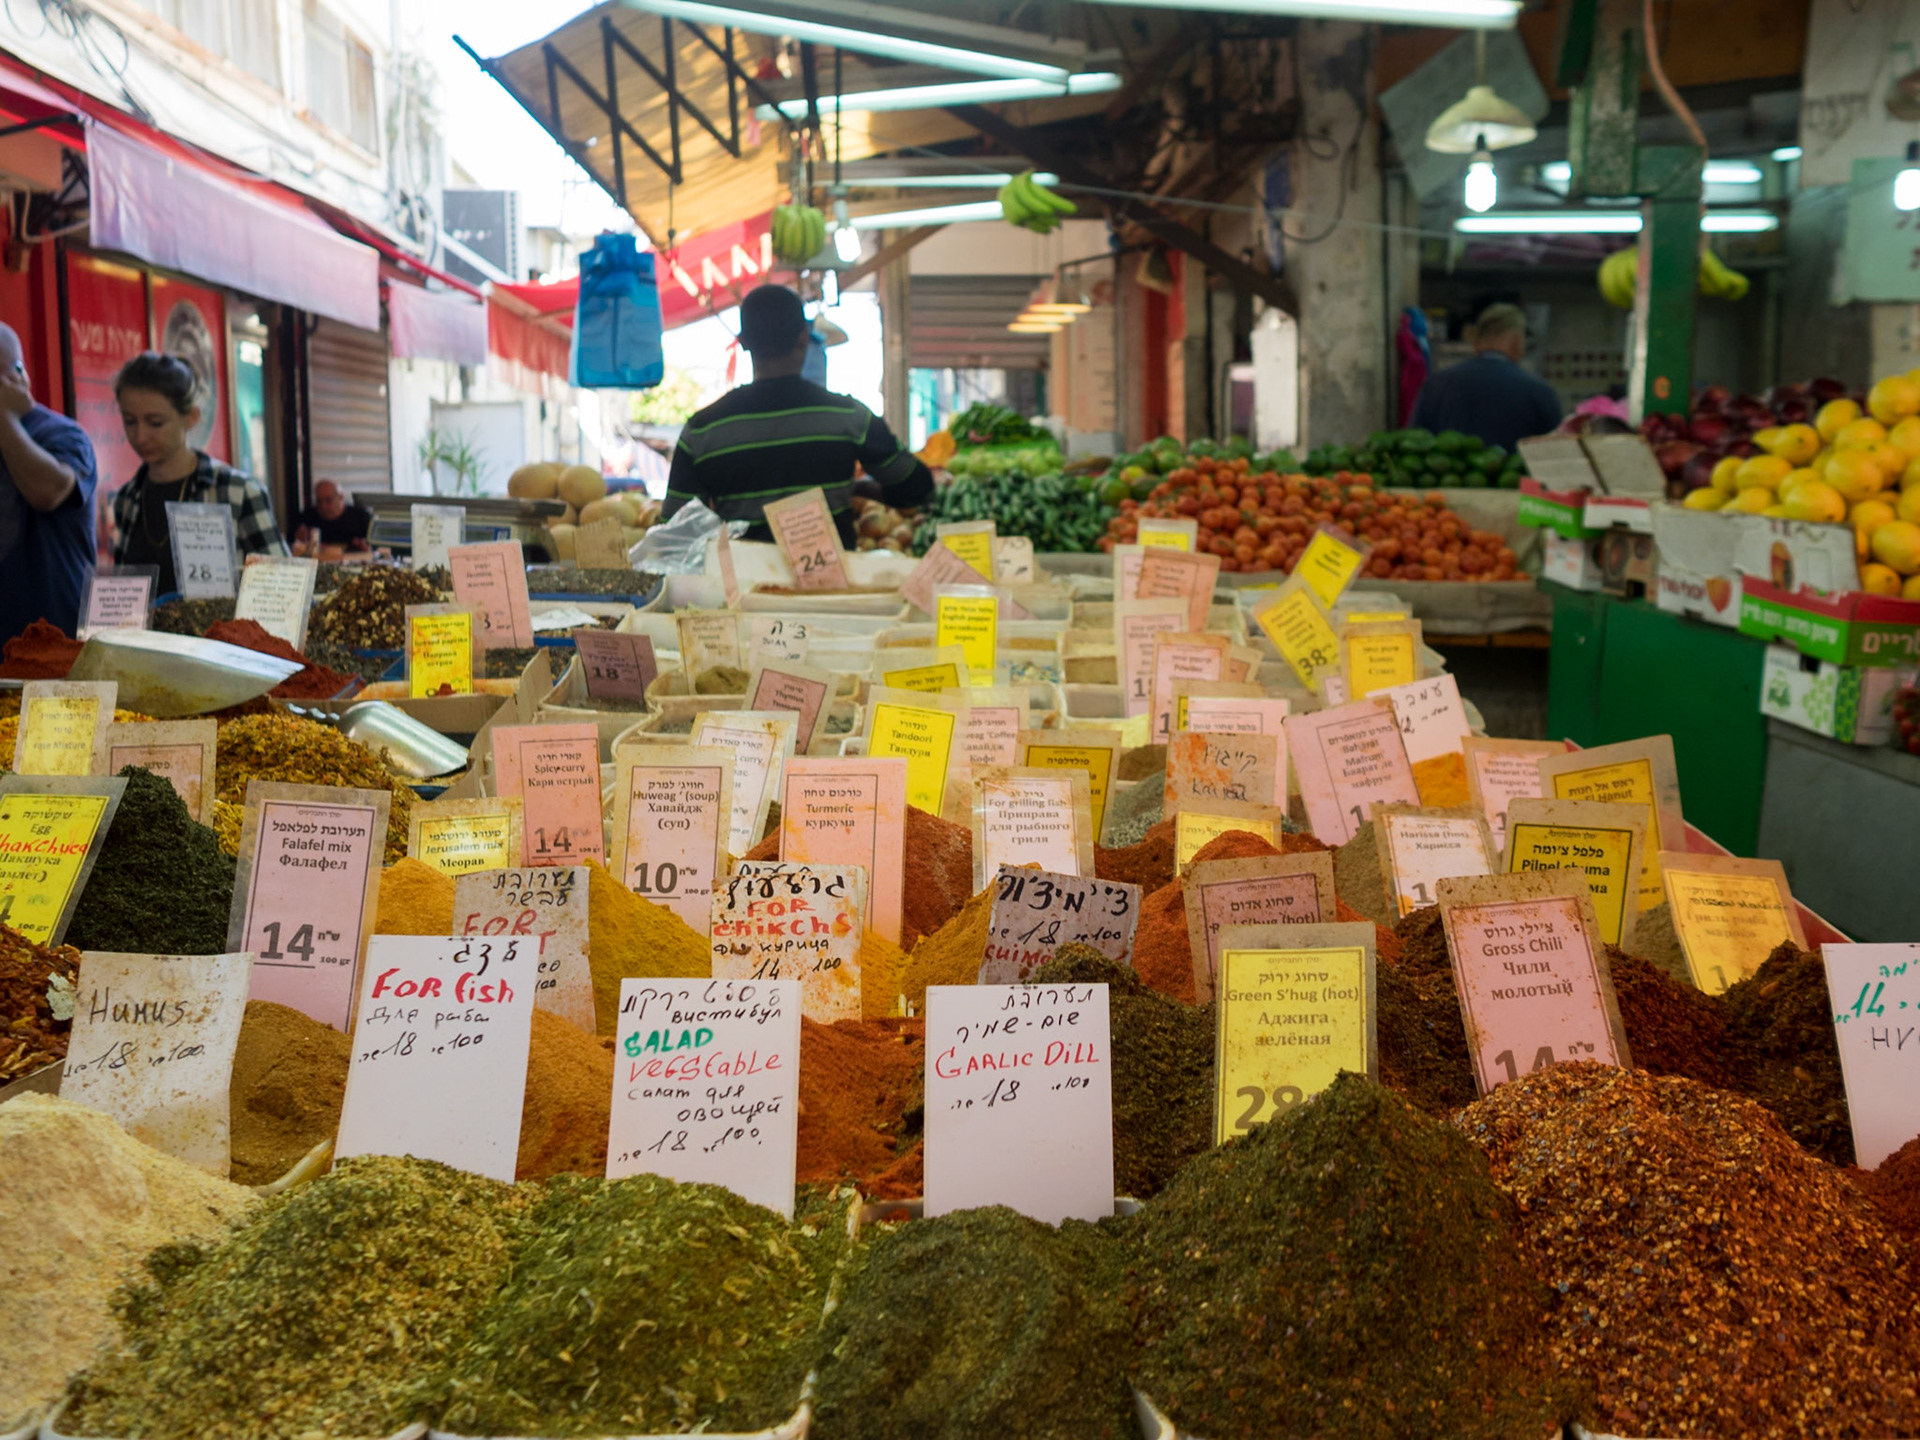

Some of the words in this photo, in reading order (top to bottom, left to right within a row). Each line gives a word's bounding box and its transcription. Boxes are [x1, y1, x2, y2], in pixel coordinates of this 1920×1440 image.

[800, 550, 826, 572] 24
[188, 563, 213, 583] 28
[1298, 648, 1328, 677] 38
[591, 667, 620, 679] 18
[892, 728, 933, 745] Tandoori
[889, 741, 931, 758] Тандури
[534, 763, 560, 776] Spicy
[561, 763, 587, 775] curry
[648, 782, 676, 793] למרק
[829, 789, 863, 800] כורכום
[632, 790, 678, 804] Huweag
[685, 789, 721, 804] (soup)
[803, 789, 827, 802] טחון
[647, 801, 704, 816] Хавайдж
[805, 803, 855, 815] Turmeric
[988, 799, 1006, 807] For
[1009, 798, 1046, 810] grilling
[1048, 797, 1068, 807] fish
[998, 809, 1061, 821] Приправа
[30, 823, 53, 835] Egg
[272, 820, 318, 835] לפלאפל
[319, 825, 366, 839] תערובת
[657, 818, 691, 833] (суп)
[805, 818, 856, 833] куркума
[988, 823, 1013, 833] для
[1015, 822, 1071, 835] рыбного
[534, 826, 573, 854] 14
[1011, 835, 1049, 847] гриля
[1400, 831, 1440, 840] Harissa
[281, 838, 325, 853] Falafel
[327, 842, 352, 855] mix
[425, 841, 481, 855] Jerusalem
[1415, 842, 1462, 852] Харисса
[1532, 844, 1570, 856] צ'ומה
[1573, 846, 1605, 860] פלפל
[279, 854, 348, 871] Фалафел
[632, 862, 679, 895] 10
[678, 866, 699, 877] ש"ח
[684, 887, 700, 896] 100
[700, 888, 711, 898] gr
[746, 898, 817, 918] FOR
[1229, 899, 1262, 912] אדום
[1265, 896, 1295, 908] סחוג
[462, 909, 538, 938] FOR
[1520, 922, 1554, 936] צ'ילי
[1016, 919, 1061, 945] 18
[1483, 925, 1517, 940] גרוס
[259, 921, 316, 962] 14
[317, 930, 341, 941] ש"ח
[760, 938, 830, 953] курица
[1482, 940, 1527, 958] Gross
[1529, 935, 1564, 954] Chili
[319, 956, 338, 964] 100
[339, 957, 352, 967] gr
[751, 957, 781, 981] 14
[1502, 961, 1552, 978] Чили
[1258, 973, 1290, 987] ירוק
[1294, 972, 1330, 984] סחוג
[371, 967, 442, 1000] FOR
[454, 971, 515, 1005] fish
[1491, 979, 1575, 1002] молотый
[1226, 990, 1272, 1003] Green
[1276, 987, 1319, 1004] S'hug
[1321, 985, 1360, 1004] (hot)
[1851, 981, 1885, 1019] 14
[366, 1005, 420, 1025] Для
[381, 1030, 418, 1058] 18
[448, 1032, 485, 1050] 100
[624, 1026, 715, 1058] SALAD
[1254, 1033, 1332, 1048] зелёная
[89, 1041, 139, 1071] 18
[1567, 1041, 1595, 1056] ש"ח
[934, 1044, 1035, 1079] GARLIC
[627, 1087, 691, 1102] салат
[980, 1077, 1021, 1108] 18
[676, 1095, 784, 1124] овощей
[1234, 1085, 1304, 1131] 28
[647, 1129, 690, 1155] 18
